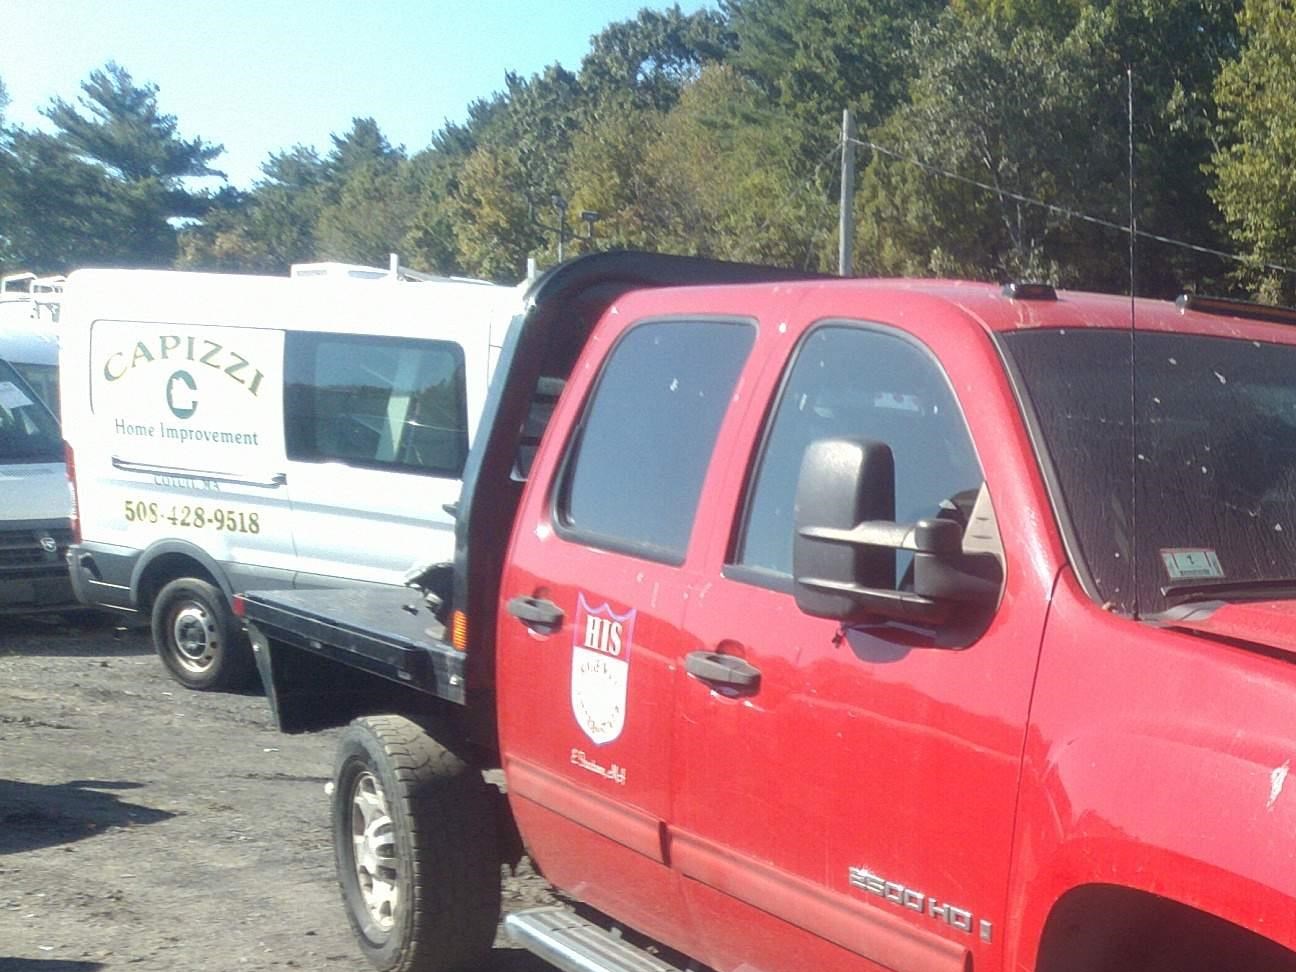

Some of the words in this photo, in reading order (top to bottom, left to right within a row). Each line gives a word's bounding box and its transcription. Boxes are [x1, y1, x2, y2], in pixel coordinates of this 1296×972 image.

[103, 335, 264, 397] CAPIZZI
[114, 418, 155, 438] Home
[160, 422, 259, 446] Improvement
[124, 500, 261, 535] 508-428-9518
[584, 615, 623, 657] HIS
[848, 865, 925, 913] 2500
[928, 897, 973, 933] HD
